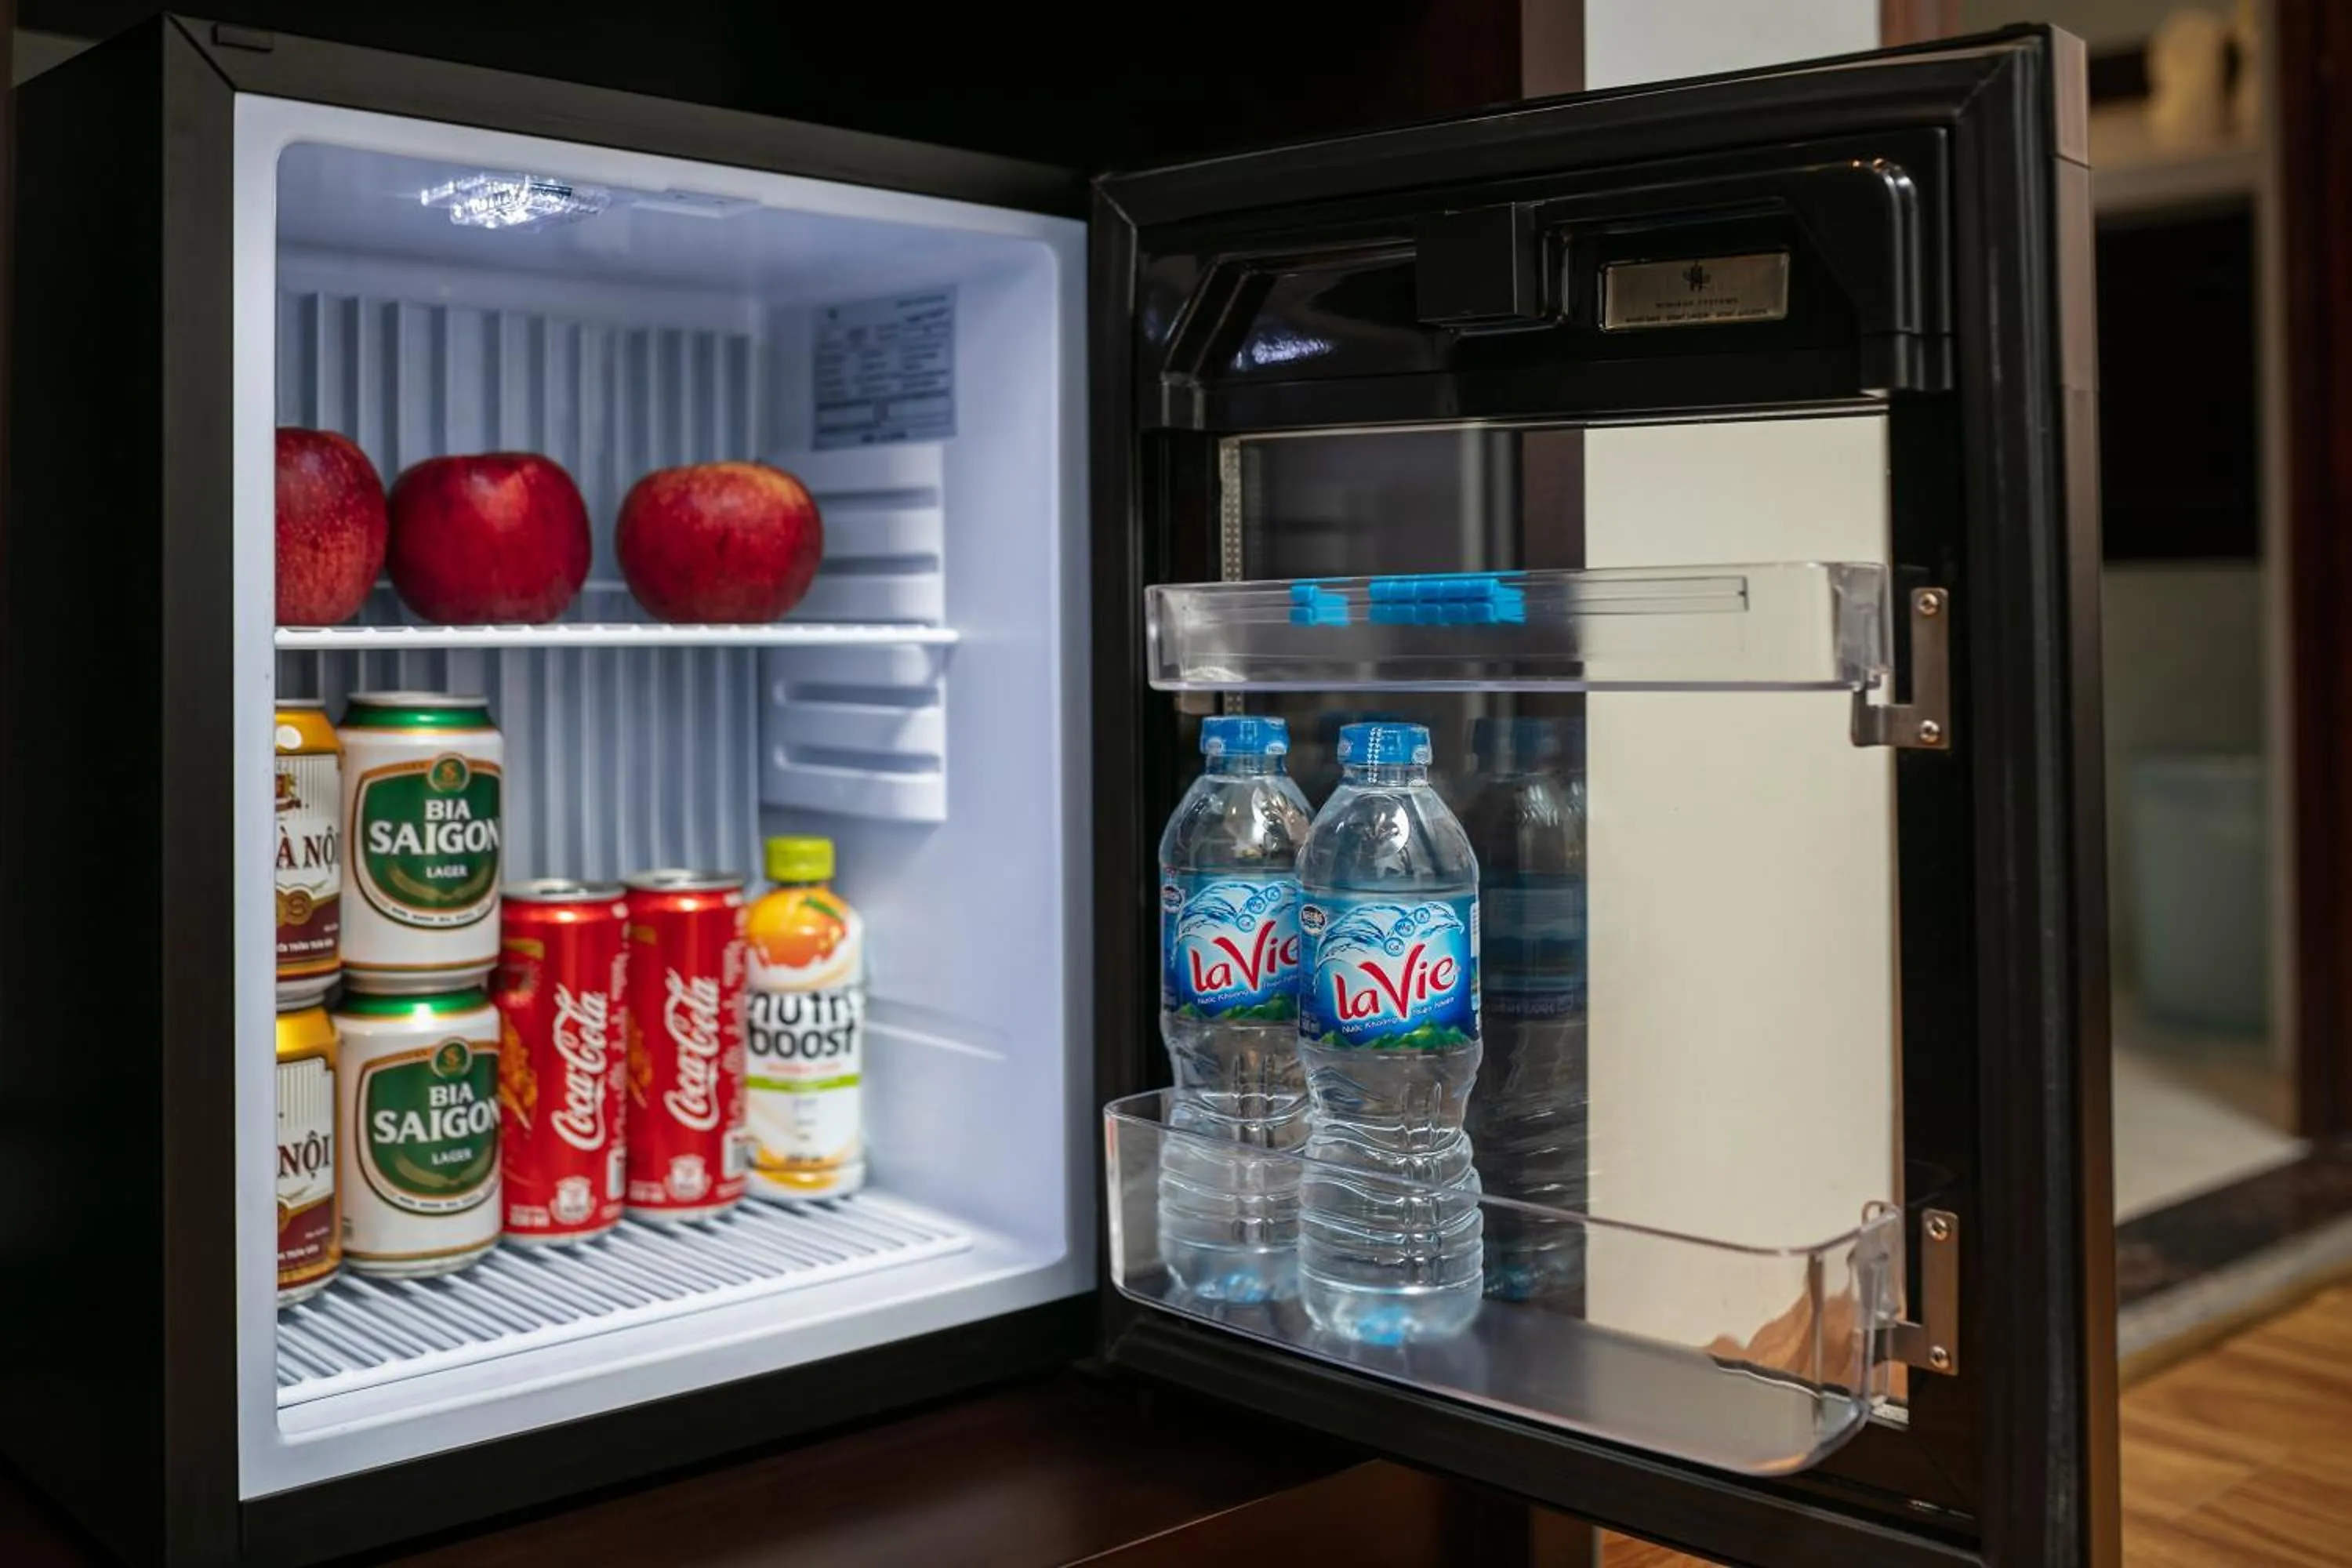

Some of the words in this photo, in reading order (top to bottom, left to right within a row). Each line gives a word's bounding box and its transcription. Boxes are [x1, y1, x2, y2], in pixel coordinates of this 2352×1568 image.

[425, 798, 471, 820] BIA
[368, 818, 501, 855] SAIGON
[426, 864, 468, 878] LAGER
[748, 1018, 855, 1059] boost
[428, 1081, 474, 1107] BIA
[372, 1096, 502, 1145] SAIGON
[277, 1130, 332, 1181] NỘI
